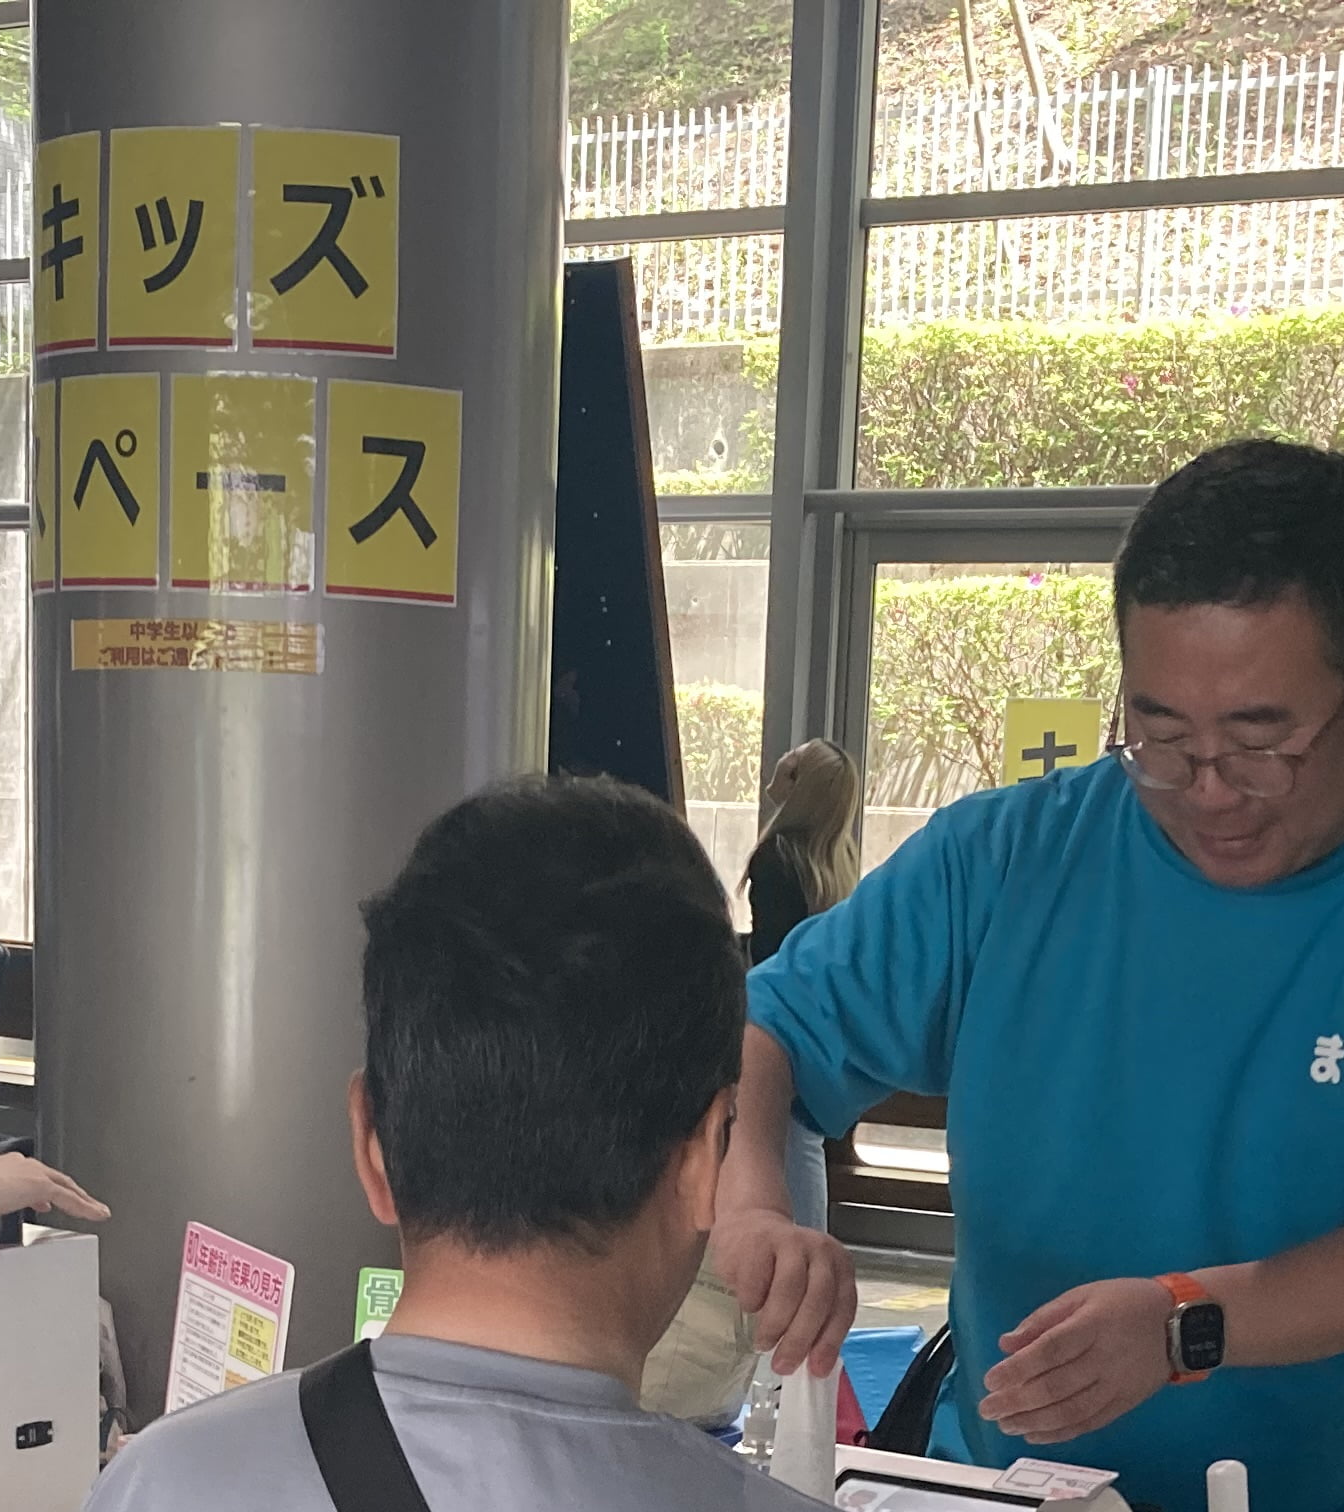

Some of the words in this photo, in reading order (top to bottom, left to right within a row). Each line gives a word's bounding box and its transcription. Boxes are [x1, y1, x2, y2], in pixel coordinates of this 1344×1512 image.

[41, 175, 385, 300] キッズ
[35, 429, 438, 550] ペース
